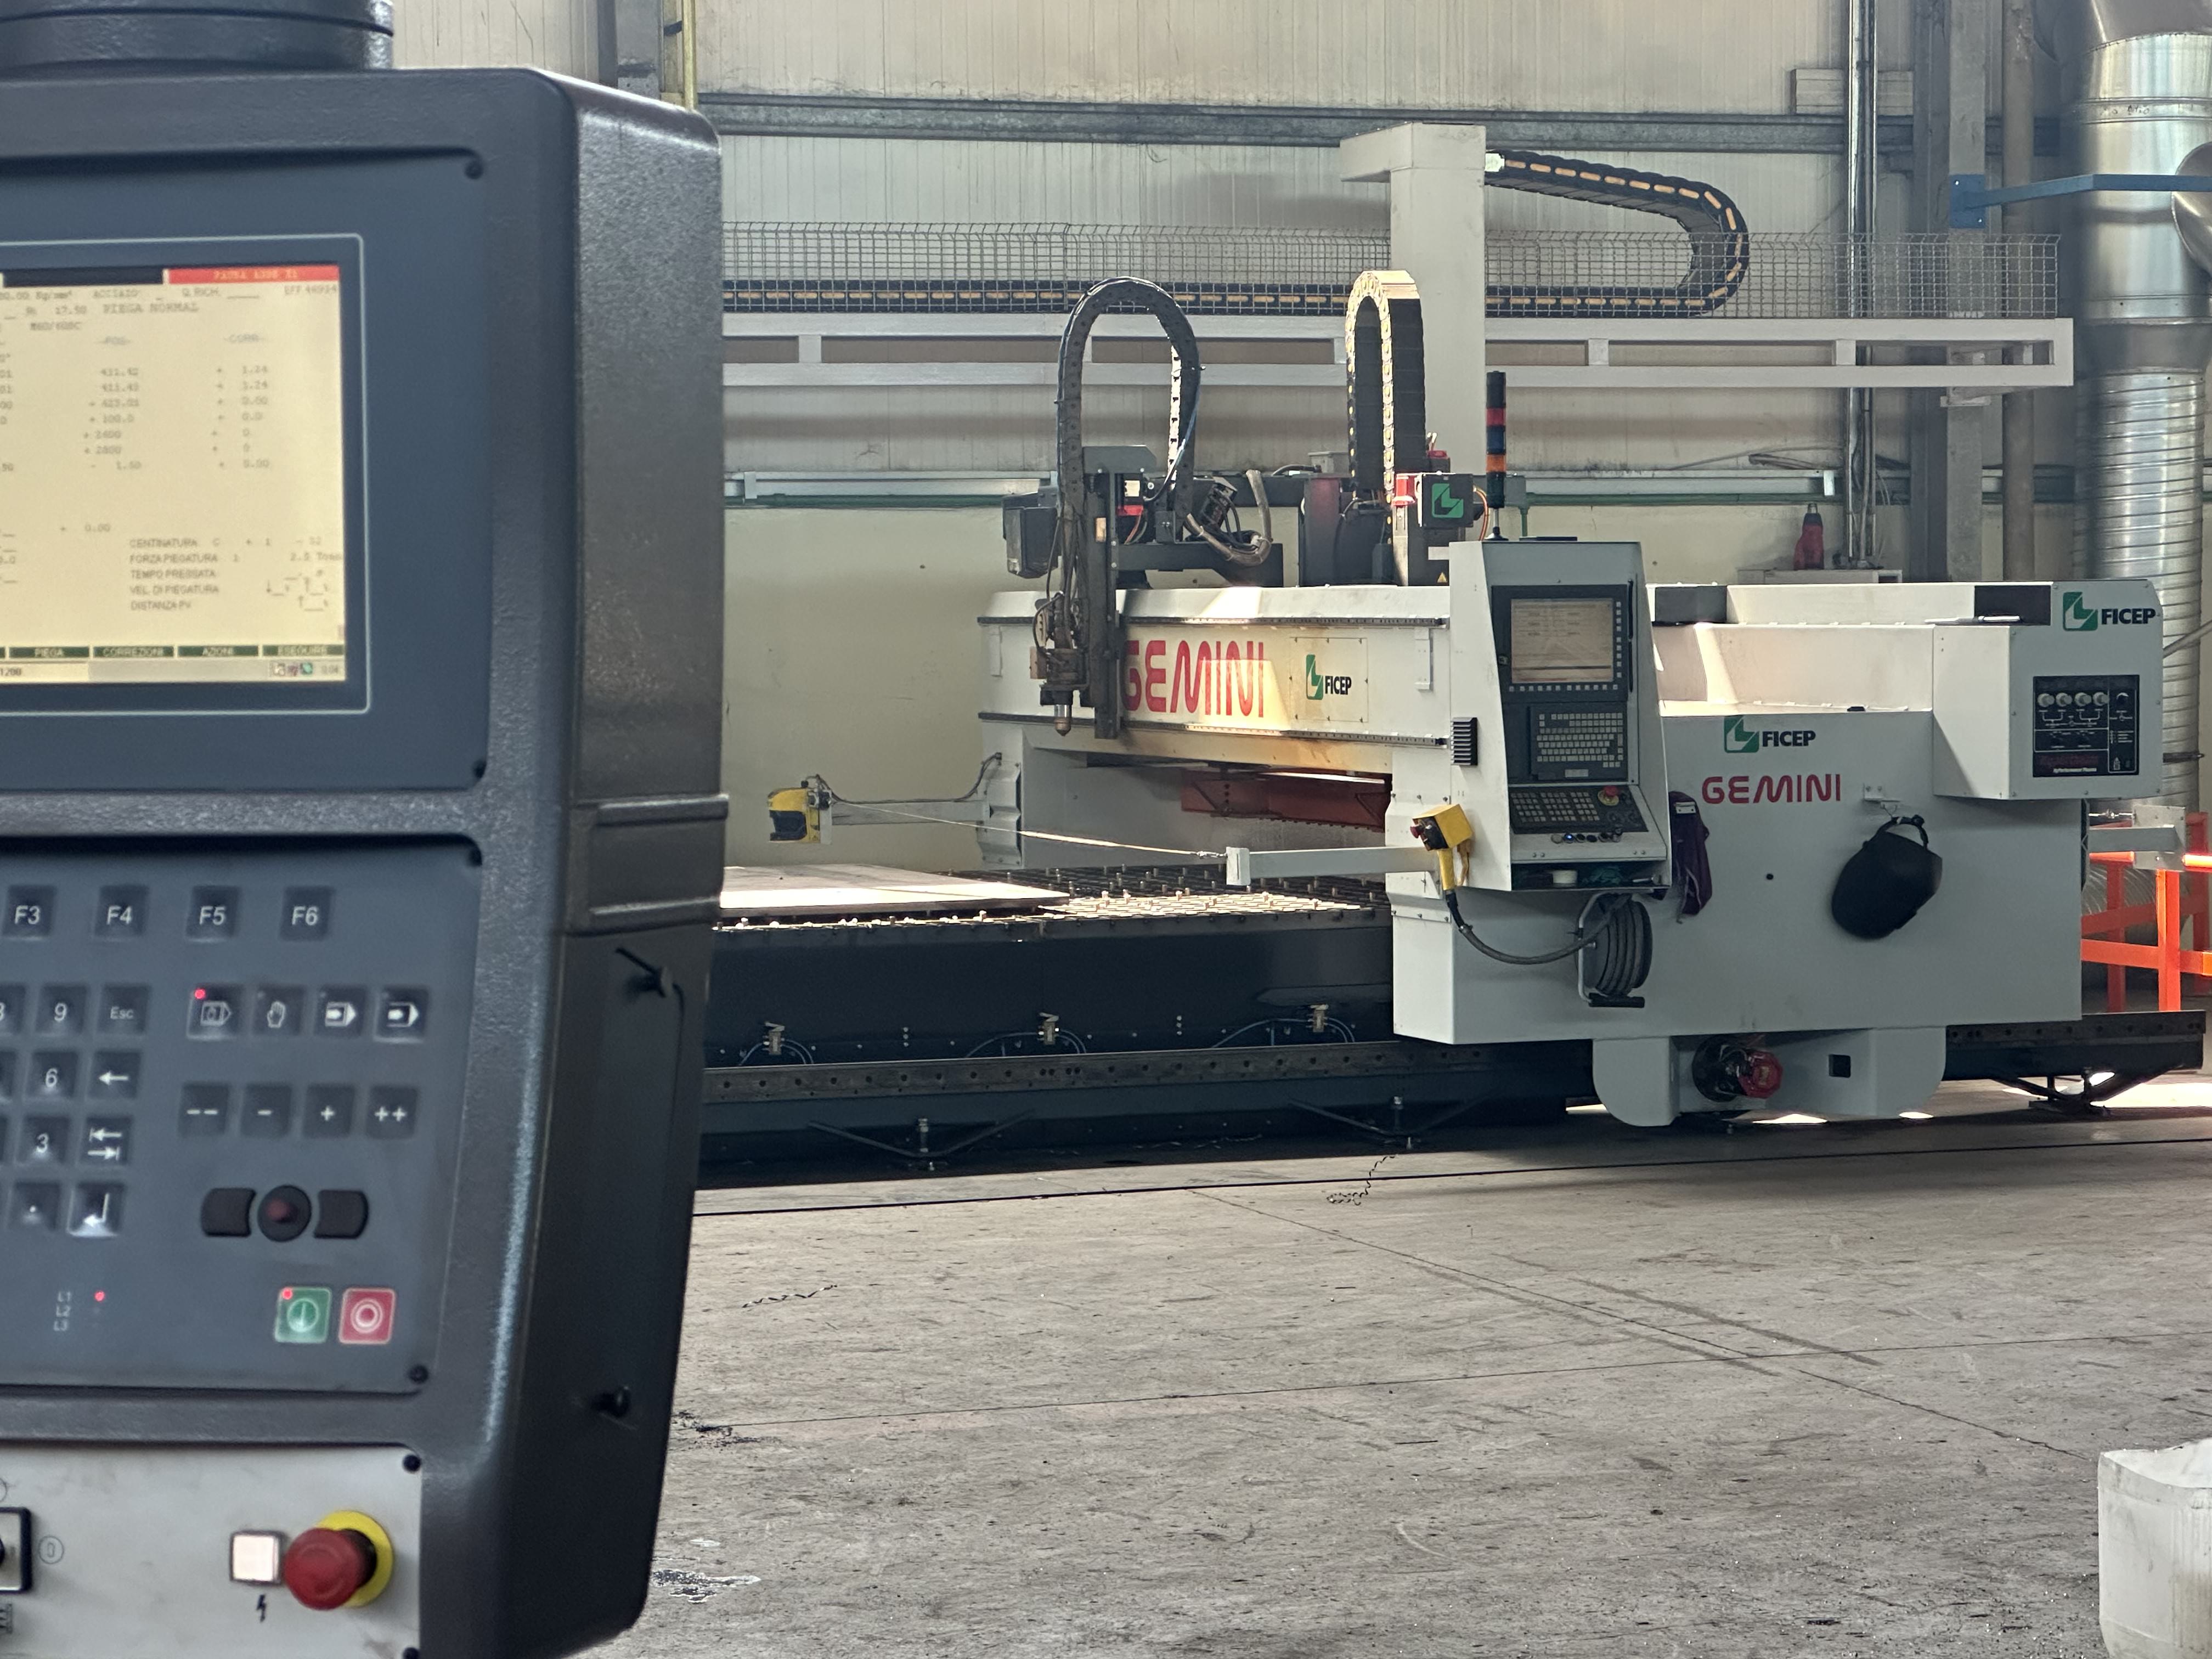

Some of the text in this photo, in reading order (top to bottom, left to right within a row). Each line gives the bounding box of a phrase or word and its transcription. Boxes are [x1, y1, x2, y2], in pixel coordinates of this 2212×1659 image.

[2101, 608, 2156, 624] FICEP
[1325, 675, 1352, 695] FICEP
[1762, 730, 1816, 747] FICEP
[1702, 774, 1841, 804] GEMINI
[14, 905, 41, 925] F3
[106, 905, 132, 925] F4
[199, 906, 225, 926] F5
[291, 906, 318, 926] F6
[54, 1002, 67, 1022] 9
[110, 1006, 134, 1020] Esc
[45, 1069, 58, 1088] 6
[36, 1132, 49, 1153] 3
